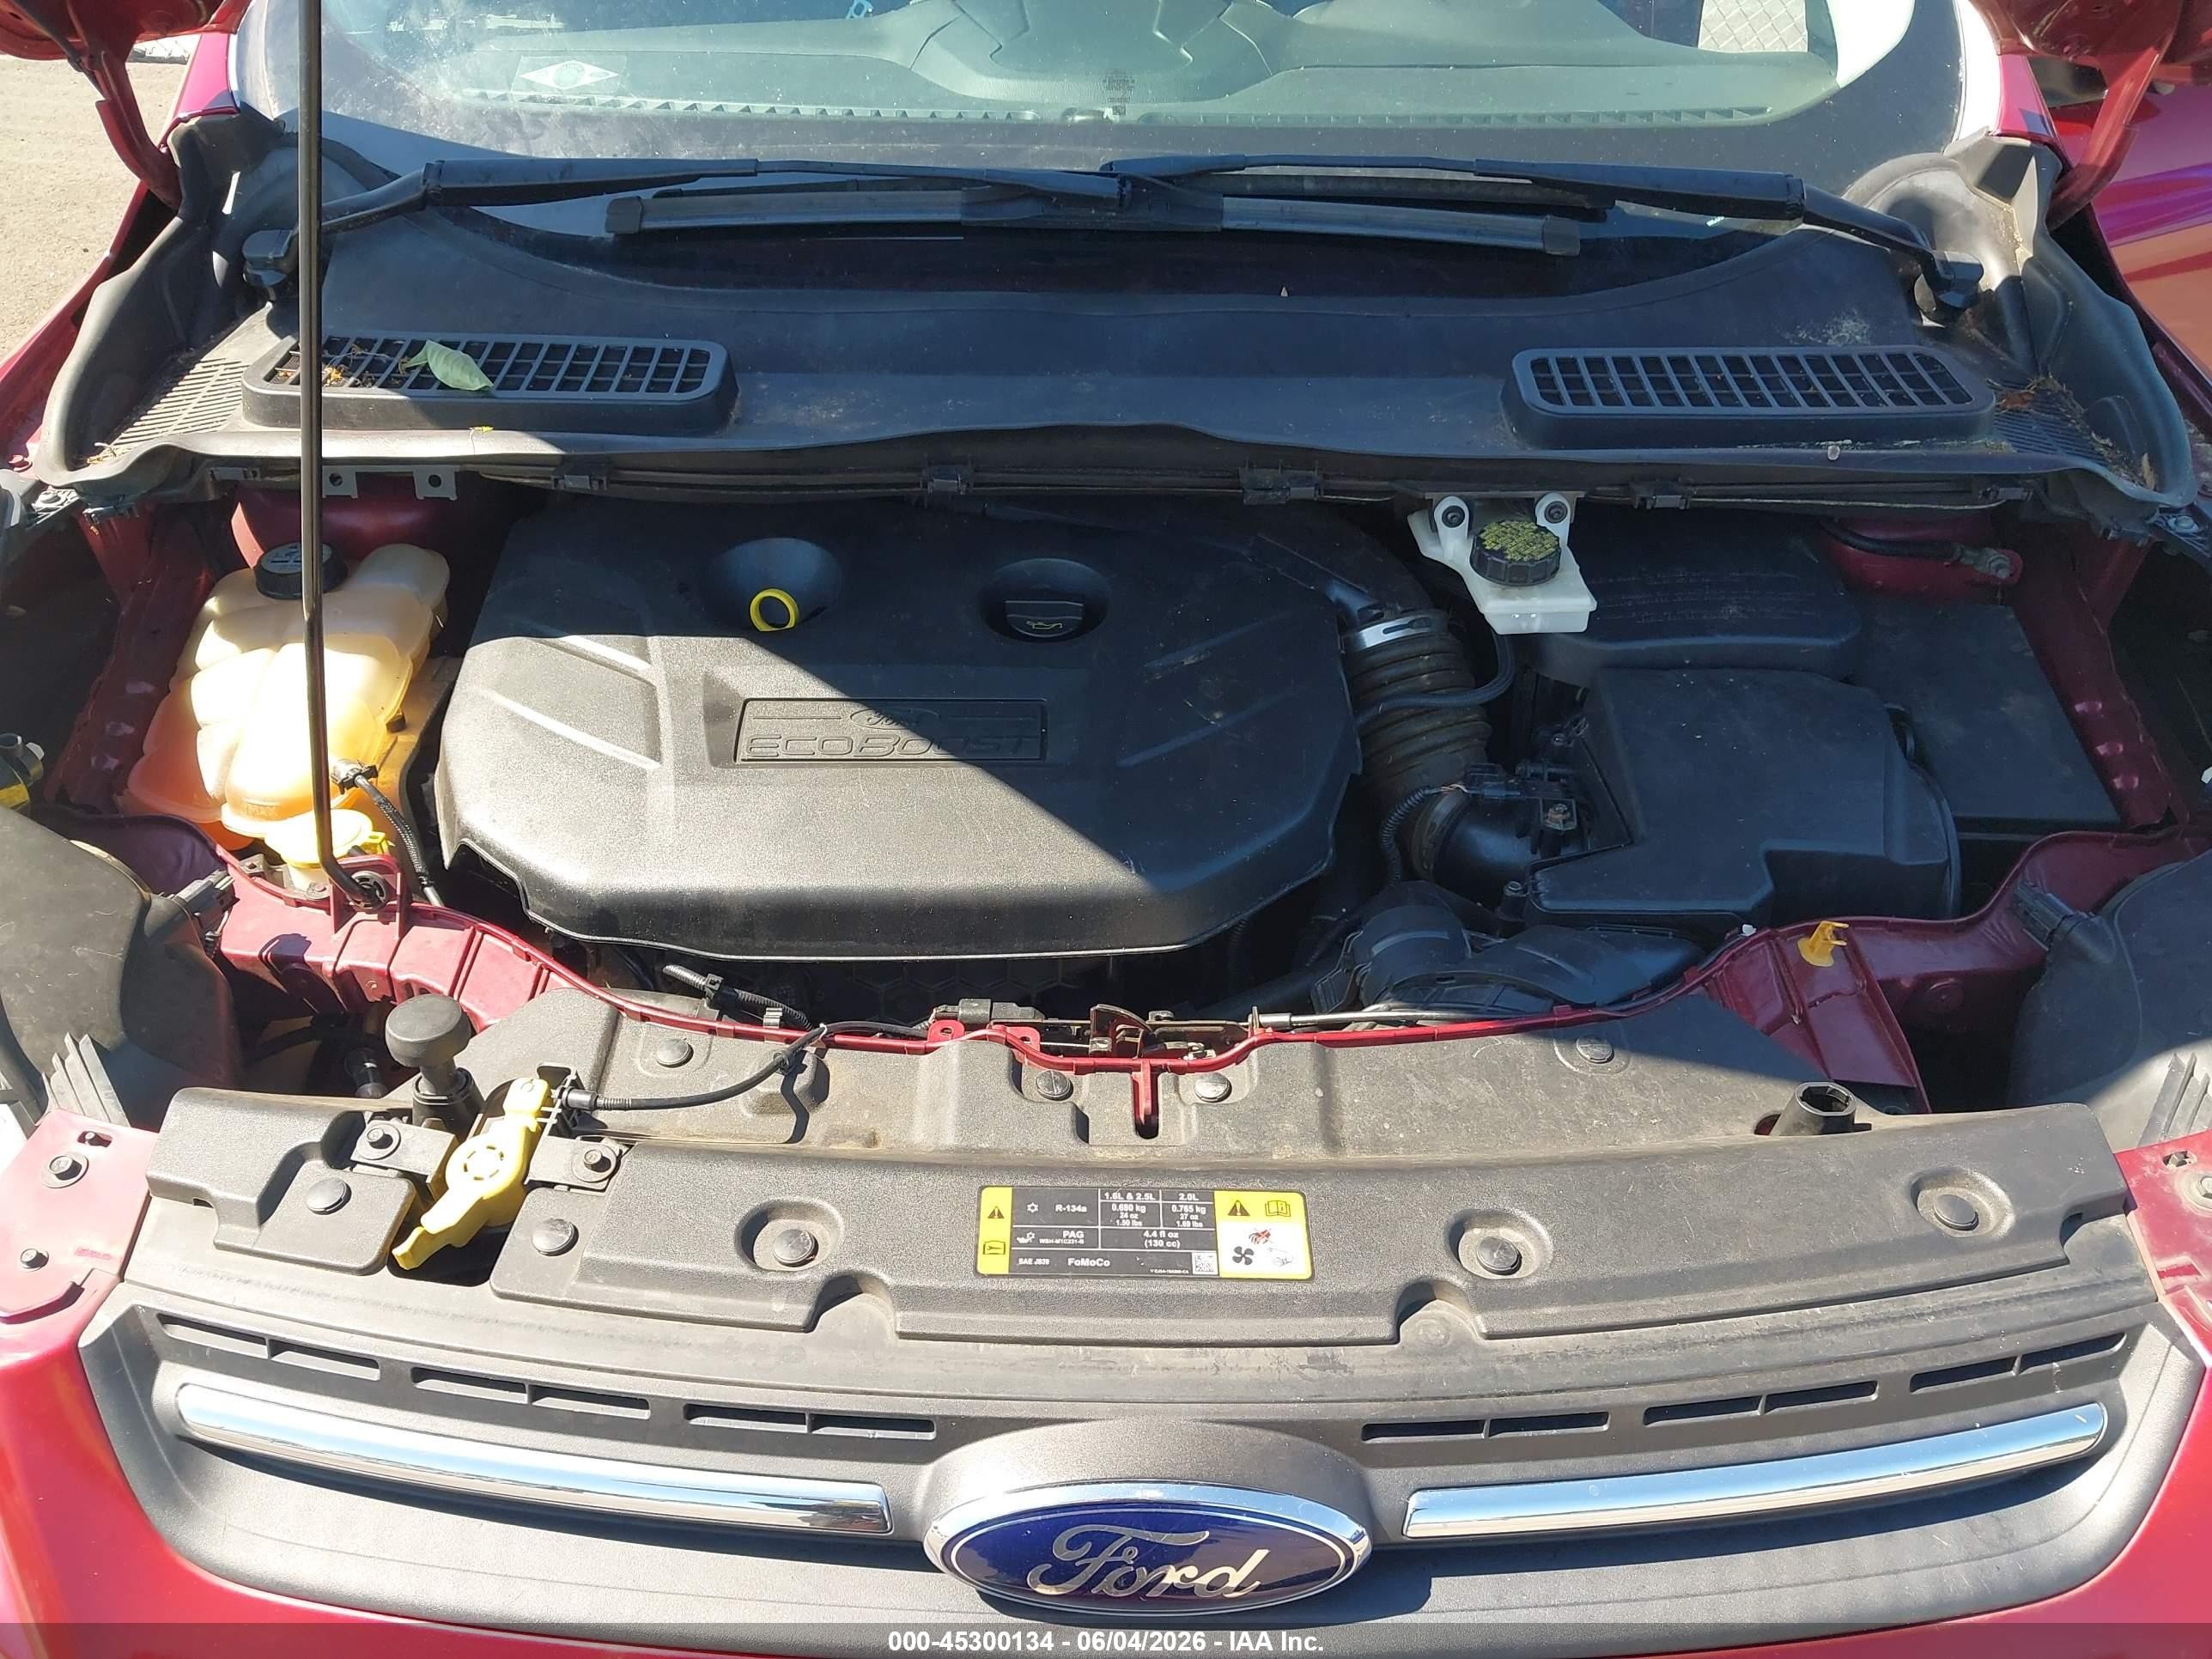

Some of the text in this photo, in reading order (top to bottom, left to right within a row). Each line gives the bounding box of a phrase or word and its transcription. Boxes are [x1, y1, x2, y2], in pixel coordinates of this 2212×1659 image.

[1179, 1193, 1199, 1201] 2.0L
[1055, 1204, 1087, 1212] R-134a
[1135, 1204, 1146, 1213] kg
[1195, 1205, 1206, 1214] kg
[1063, 1230, 1085, 1238] PAG
[1143, 1230, 1158, 1238] 4.4
[1159, 1230, 1165, 1238] fl
[1145, 1239, 1181, 1249] (130 cc)
[1067, 1256, 1110, 1265] FoMoCo
[1027, 1523, 1272, 1599] Ford
